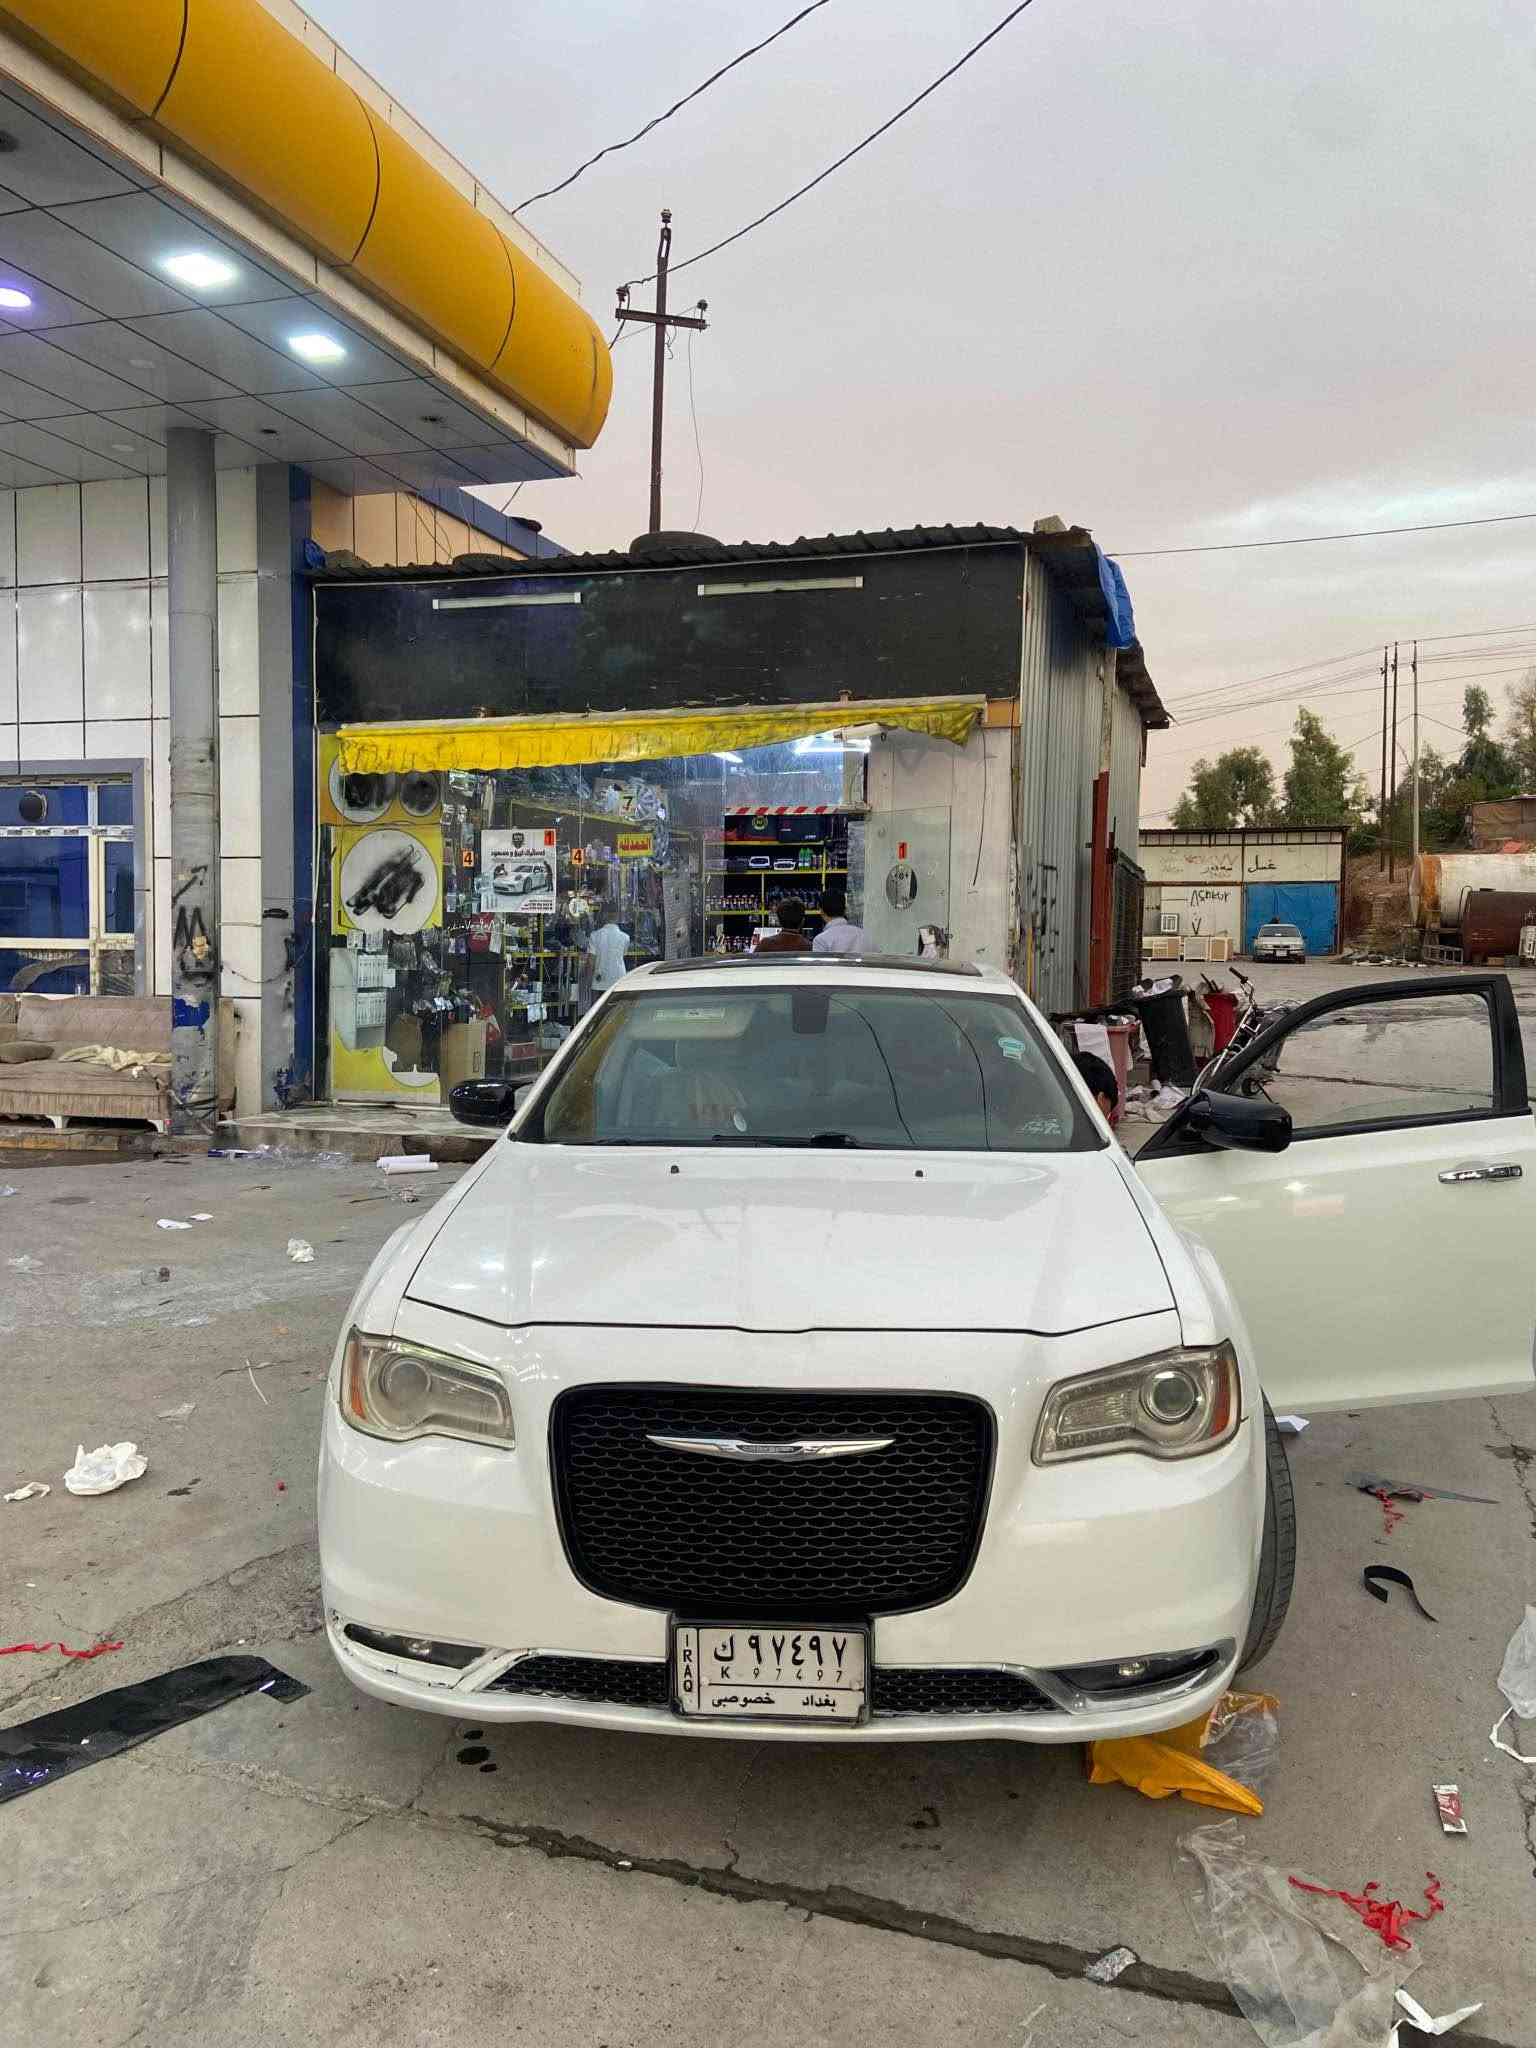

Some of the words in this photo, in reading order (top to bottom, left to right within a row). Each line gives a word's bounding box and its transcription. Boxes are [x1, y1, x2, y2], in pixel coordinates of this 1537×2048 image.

[683, 1634, 693, 1693] IRAQ
[721, 1666, 730, 1679] K
[802, 1693, 836, 1712] بغداد
